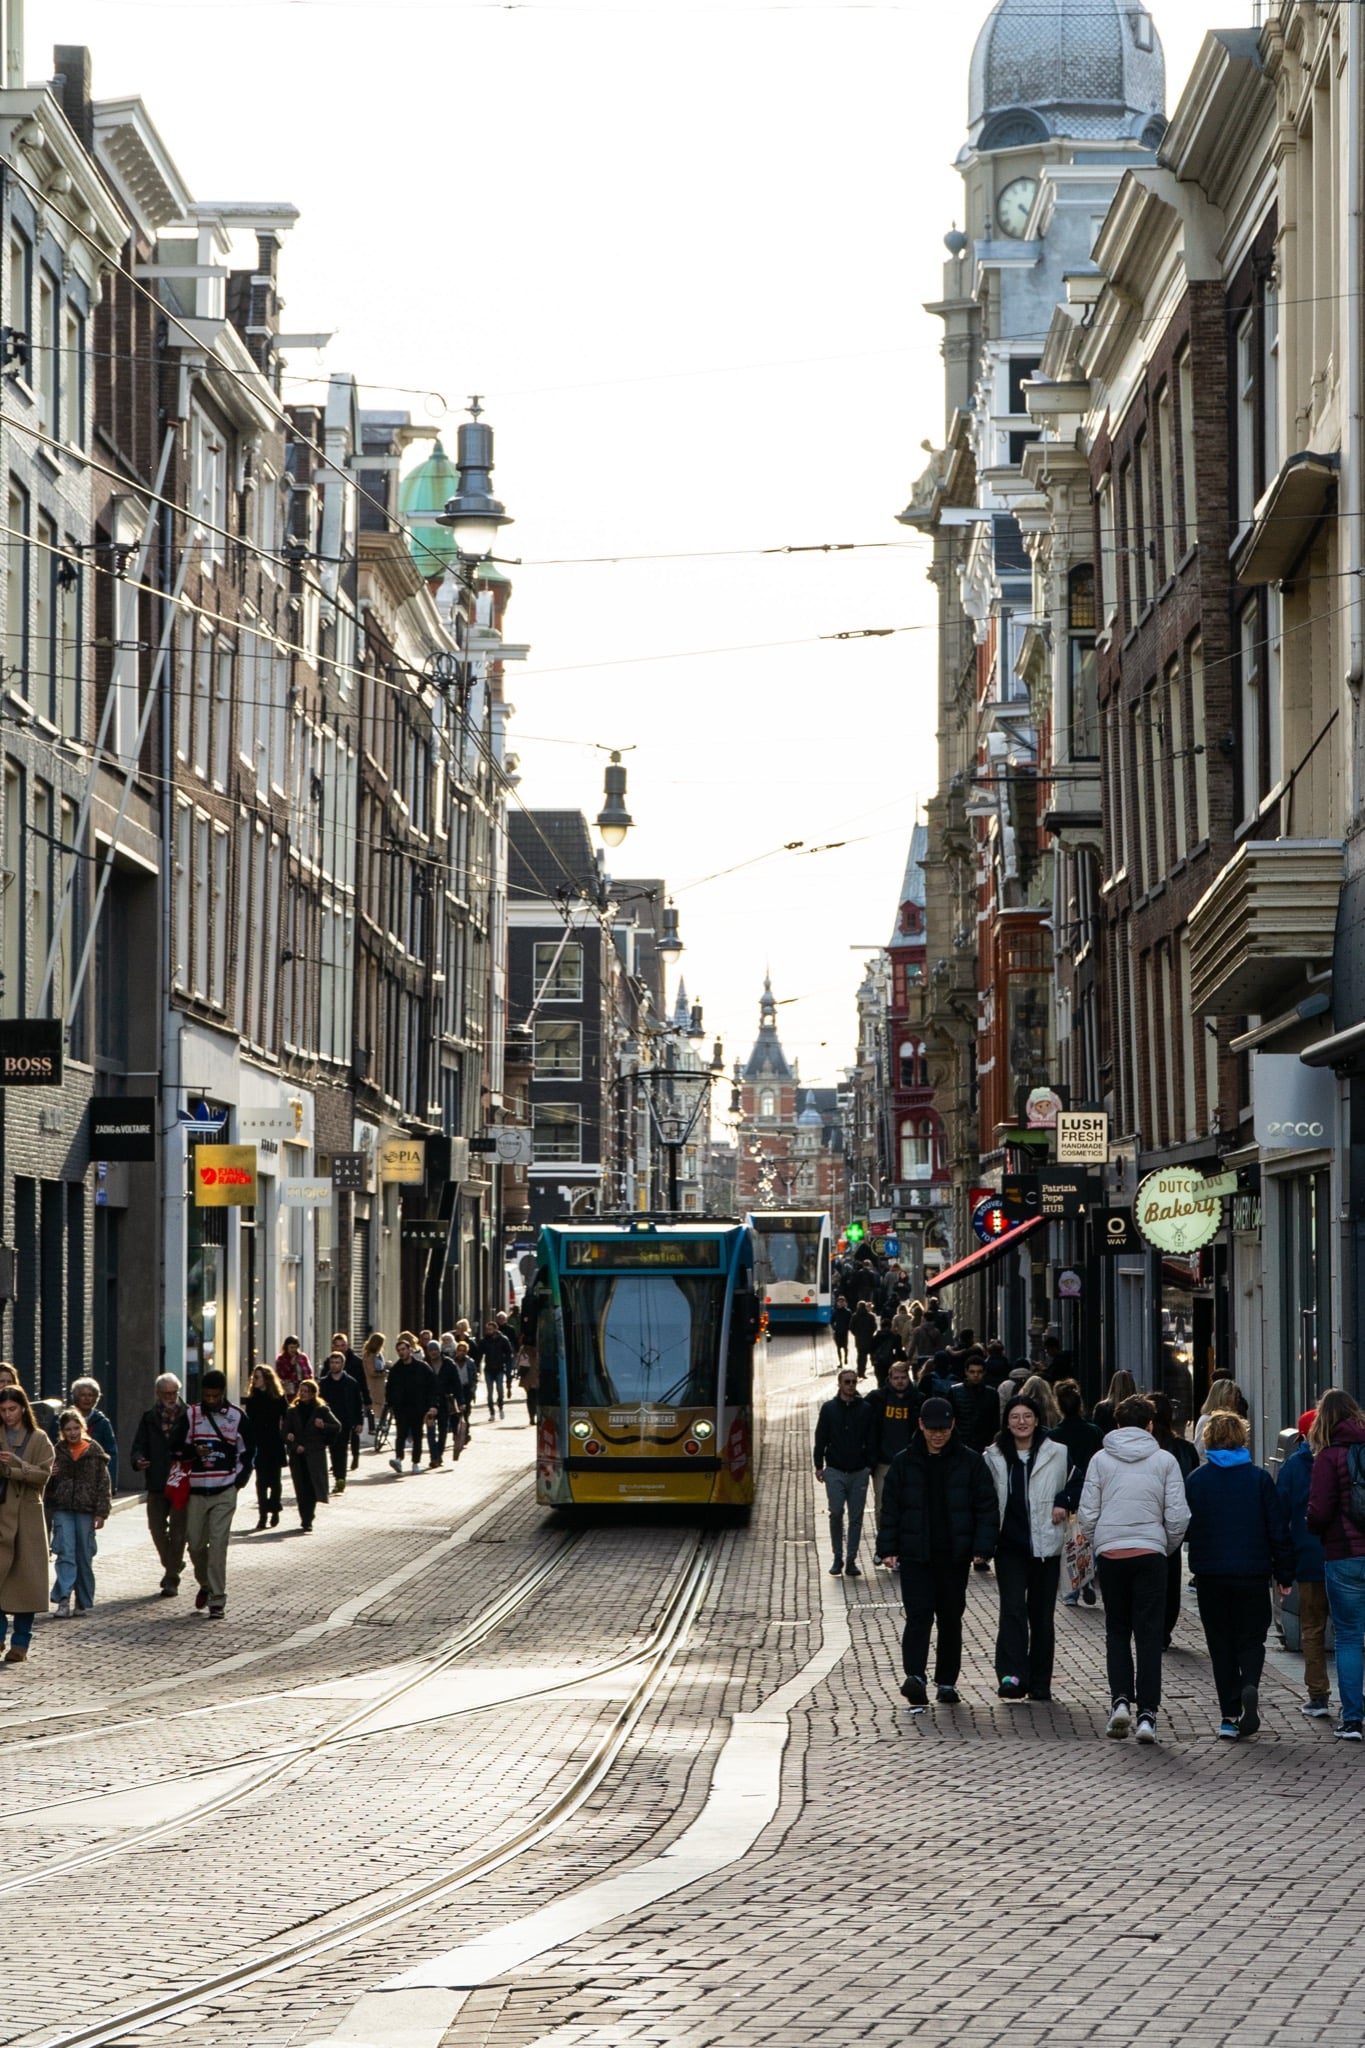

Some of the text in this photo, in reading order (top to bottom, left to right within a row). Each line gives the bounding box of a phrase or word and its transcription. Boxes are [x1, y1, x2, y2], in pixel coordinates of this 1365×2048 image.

[5, 1057, 52, 1071] BOSS
[243, 1119, 292, 1127] sandro
[1062, 1119, 1103, 1130] LUSH
[1267, 1122, 1323, 1137] ecco
[1062, 1132, 1103, 1142] FRESH
[1042, 1184, 1078, 1192] Patrizia
[1159, 1180, 1193, 1193] DUTC
[1042, 1194, 1064, 1203] Pepe
[1042, 1204, 1064, 1213] HUB
[1144, 1198, 1215, 1225] Bakery
[505, 1224, 534, 1233] sacha
[1107, 1217, 1126, 1234] O
[402, 1231, 446, 1239] FALKE
[639, 1251, 684, 1263] Station
